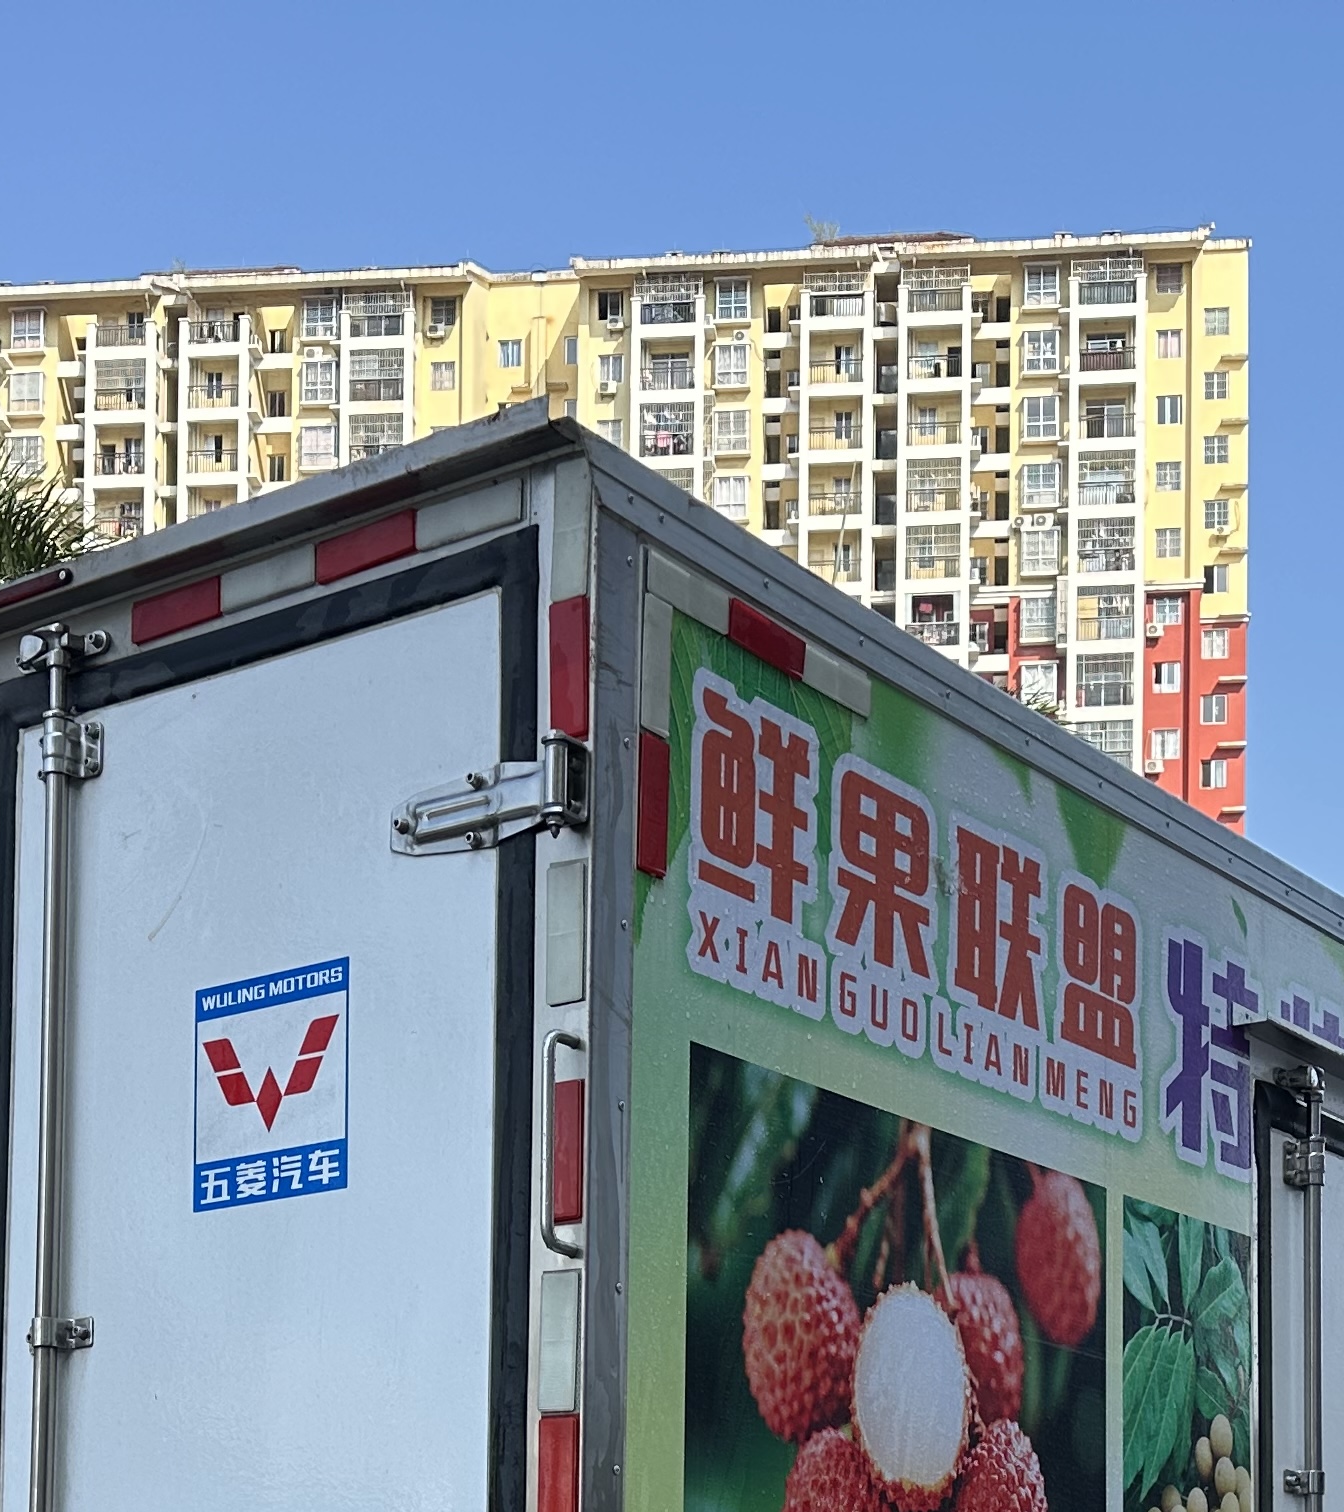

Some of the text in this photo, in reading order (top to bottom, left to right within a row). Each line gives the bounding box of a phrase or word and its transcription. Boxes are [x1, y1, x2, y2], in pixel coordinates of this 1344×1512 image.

[697, 686, 1136, 1069] 鲜果联盟
[201, 966, 343, 1012] WULING MOTORS
[200, 1148, 340, 1205] 五菱汽车
